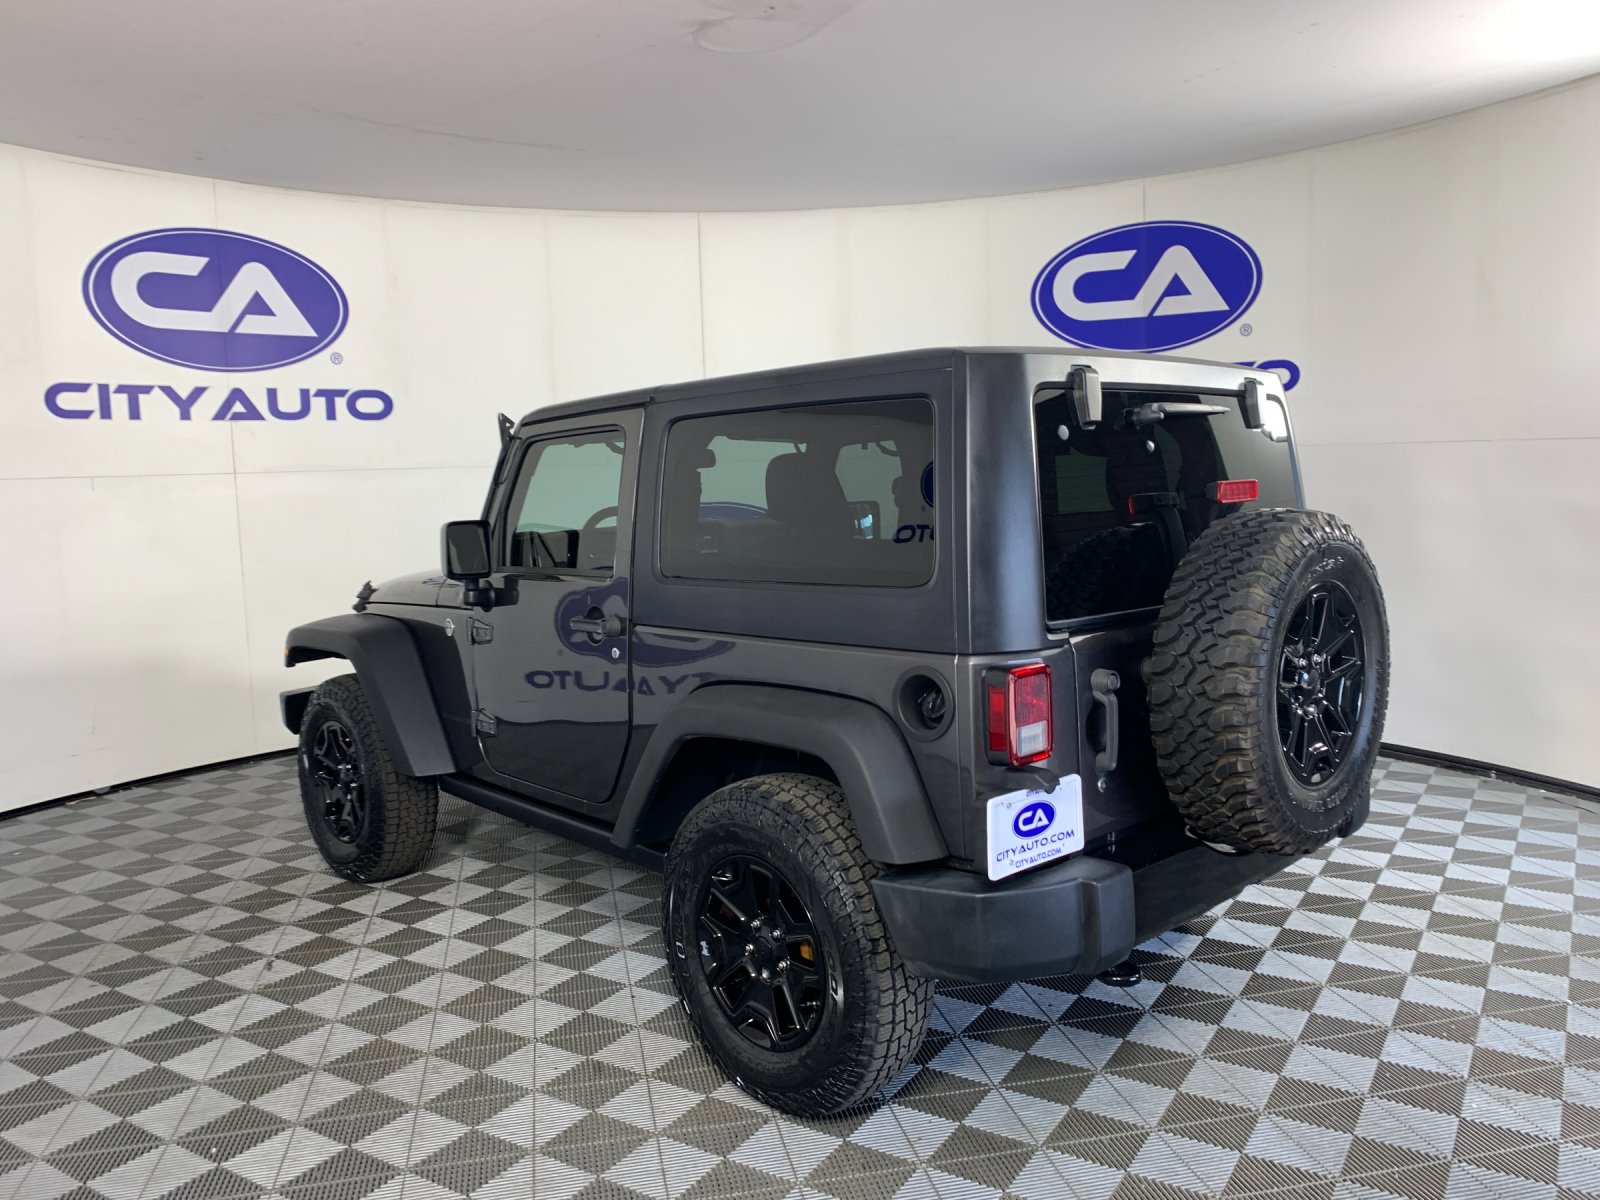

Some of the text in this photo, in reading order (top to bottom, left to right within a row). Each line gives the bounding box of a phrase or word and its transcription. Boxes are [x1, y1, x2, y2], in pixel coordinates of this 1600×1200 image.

[110, 251, 318, 337] CA
[1053, 245, 1230, 321] CA
[1018, 808, 1050, 832] CA
